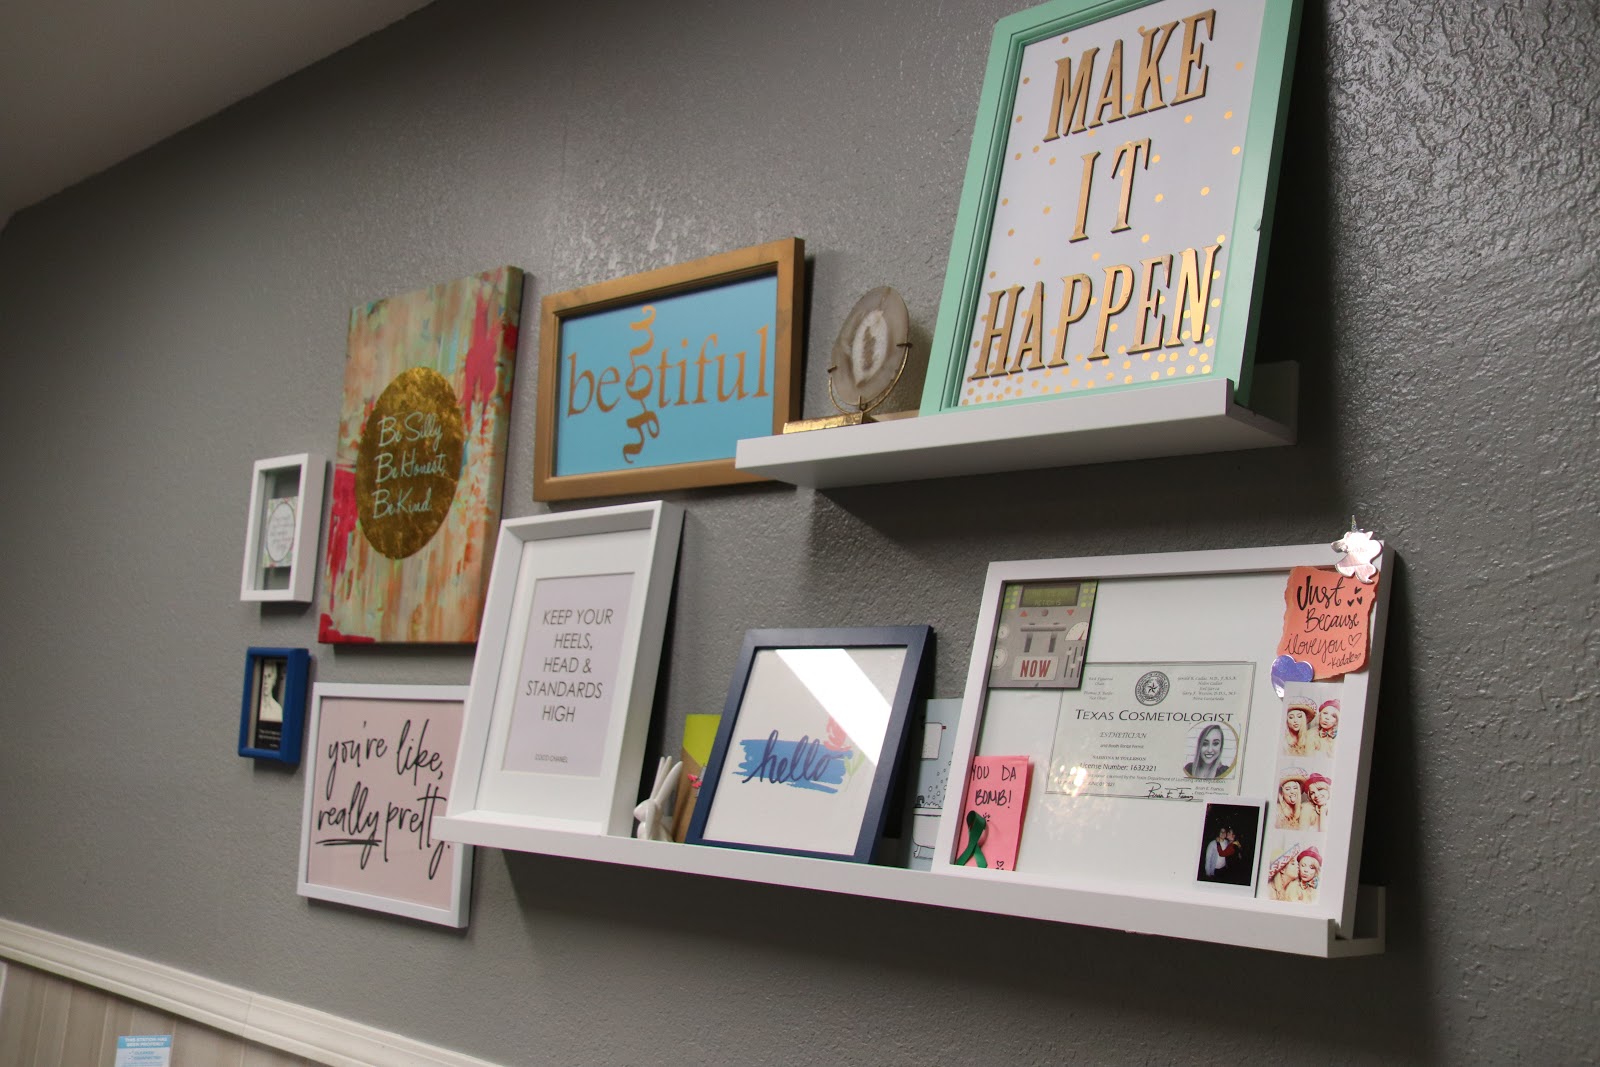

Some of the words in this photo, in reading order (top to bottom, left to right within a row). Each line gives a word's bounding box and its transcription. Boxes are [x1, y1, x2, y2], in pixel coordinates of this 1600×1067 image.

[1043, 9, 1216, 142] MAKE
[1068, 138, 1152, 243] IT
[970, 243, 1222, 380] HAPPEN
[378, 416, 402, 447] Be
[374, 452, 398, 483] Be
[371, 488, 394, 519] Be
[1297, 575, 1345, 611] Just
[542, 609, 573, 625] KEEP
[576, 608, 614, 625] YOUR
[1304, 608, 1360, 633] Because
[553, 632, 593, 651] HEELS,
[543, 657, 579, 673] HEAD
[582, 657, 592, 674] &
[1019, 659, 1051, 678] NOW
[525, 680, 603, 699] STANDARDS
[541, 705, 576, 723] HIGH
[1075, 709, 1114, 720] TEXAS
[1118, 710, 1233, 722] COSMETOLOGIST
[326, 720, 388, 801] you're
[397, 719, 443, 786] like,
[742, 729, 844, 784] hello
[1130, 764, 1157, 772] 1632321
[972, 765, 990, 781] YOU
[1001, 765, 1017, 782] DA
[975, 789, 1012, 809] BOMB!
[317, 781, 381, 870] really
